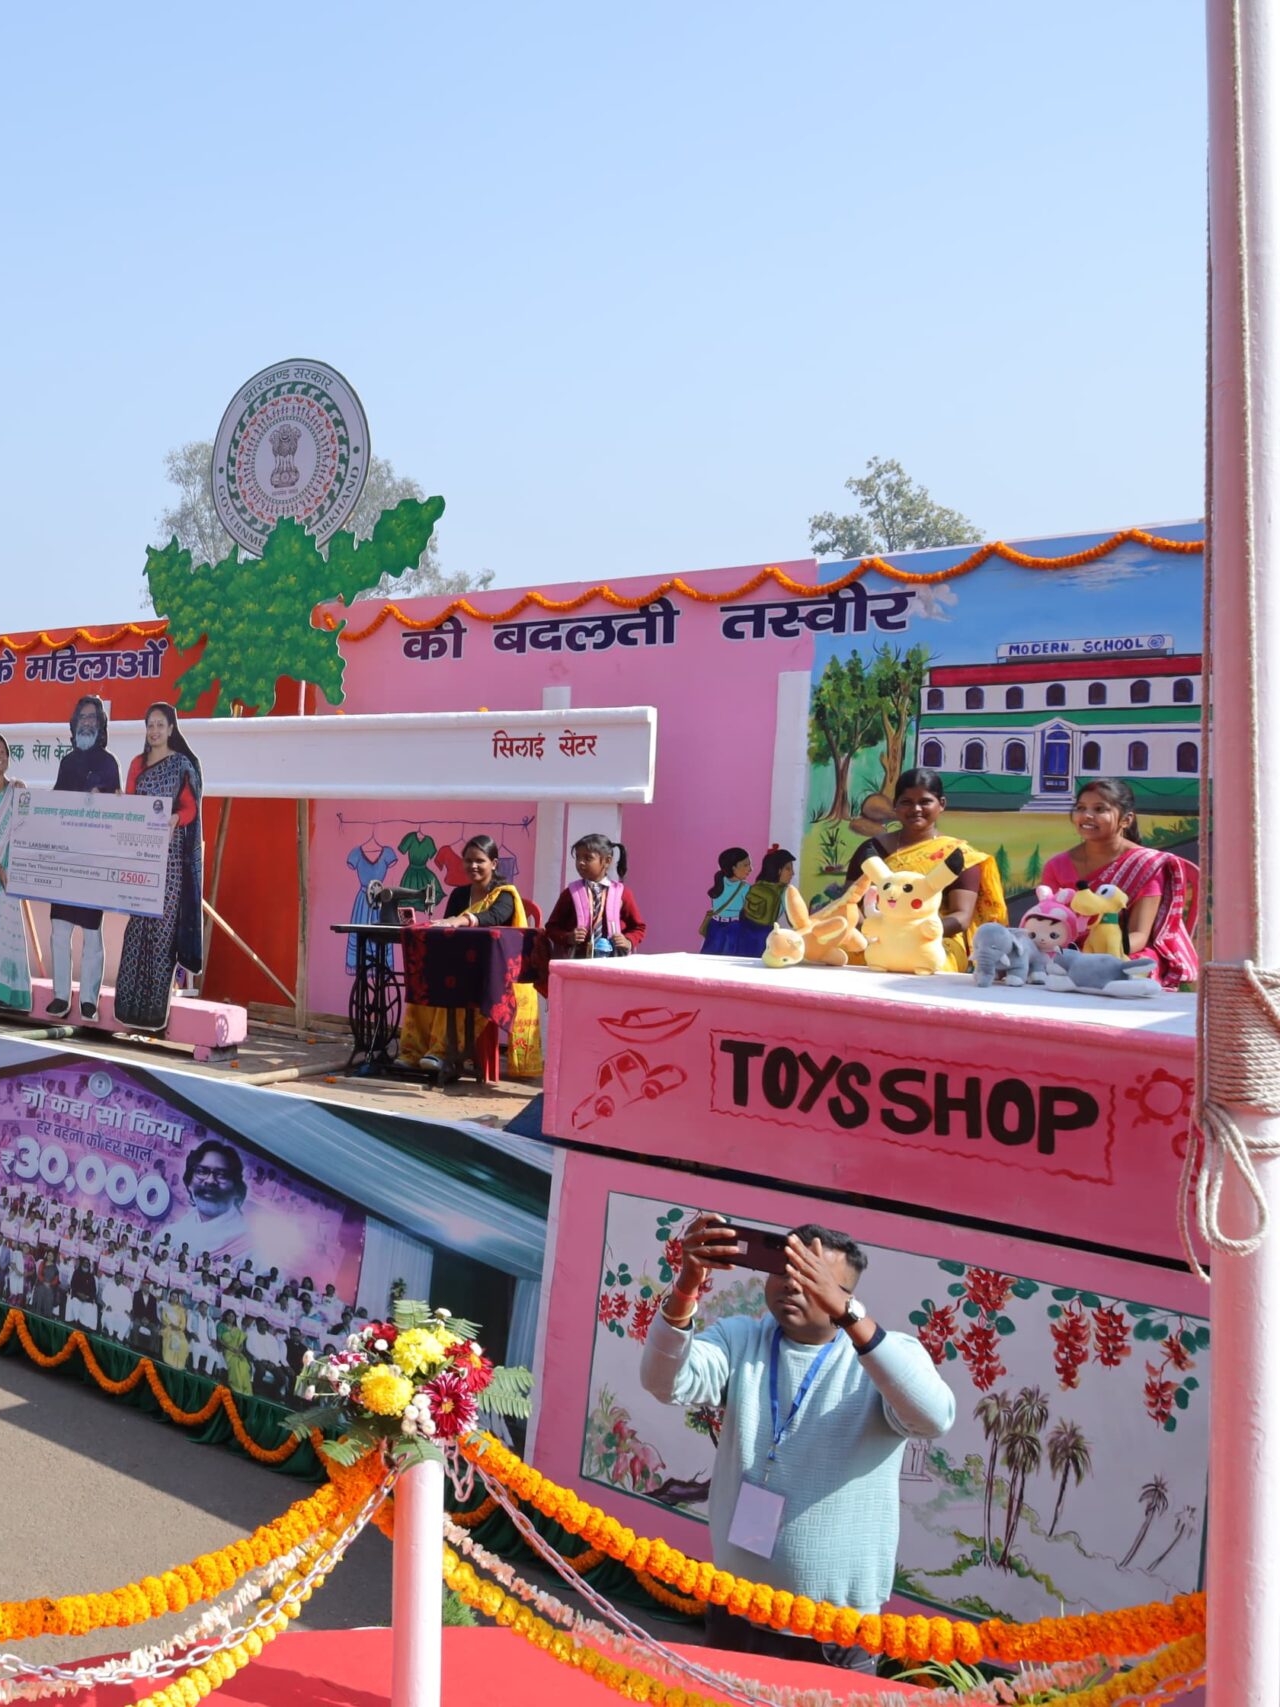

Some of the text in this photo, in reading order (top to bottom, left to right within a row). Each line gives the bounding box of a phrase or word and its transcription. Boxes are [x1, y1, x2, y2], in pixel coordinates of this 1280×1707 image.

[242, 368, 333, 403] झारखण्ड सरकार
[219, 485, 265, 547] GOVERNME
[315, 466, 359, 536] ARKHAND
[26, 639, 168, 682] महिलाओं
[402, 615, 467, 660] की
[494, 597, 681, 654] बदलती
[721, 581, 916, 640] तस्वीर
[1082, 638, 1143, 653] SCHOOL
[32, 739, 50, 763] सेवा
[492, 730, 597, 760] सिलाई सेंटर
[121, 872, 151, 884] 2500/-
[21, 1085, 185, 1144] जो कहा सो किया
[37, 1120, 52, 1135] हर
[86, 1131, 104, 1148] को
[105, 1137, 121, 1153] हर
[123, 1142, 153, 1162] साल
